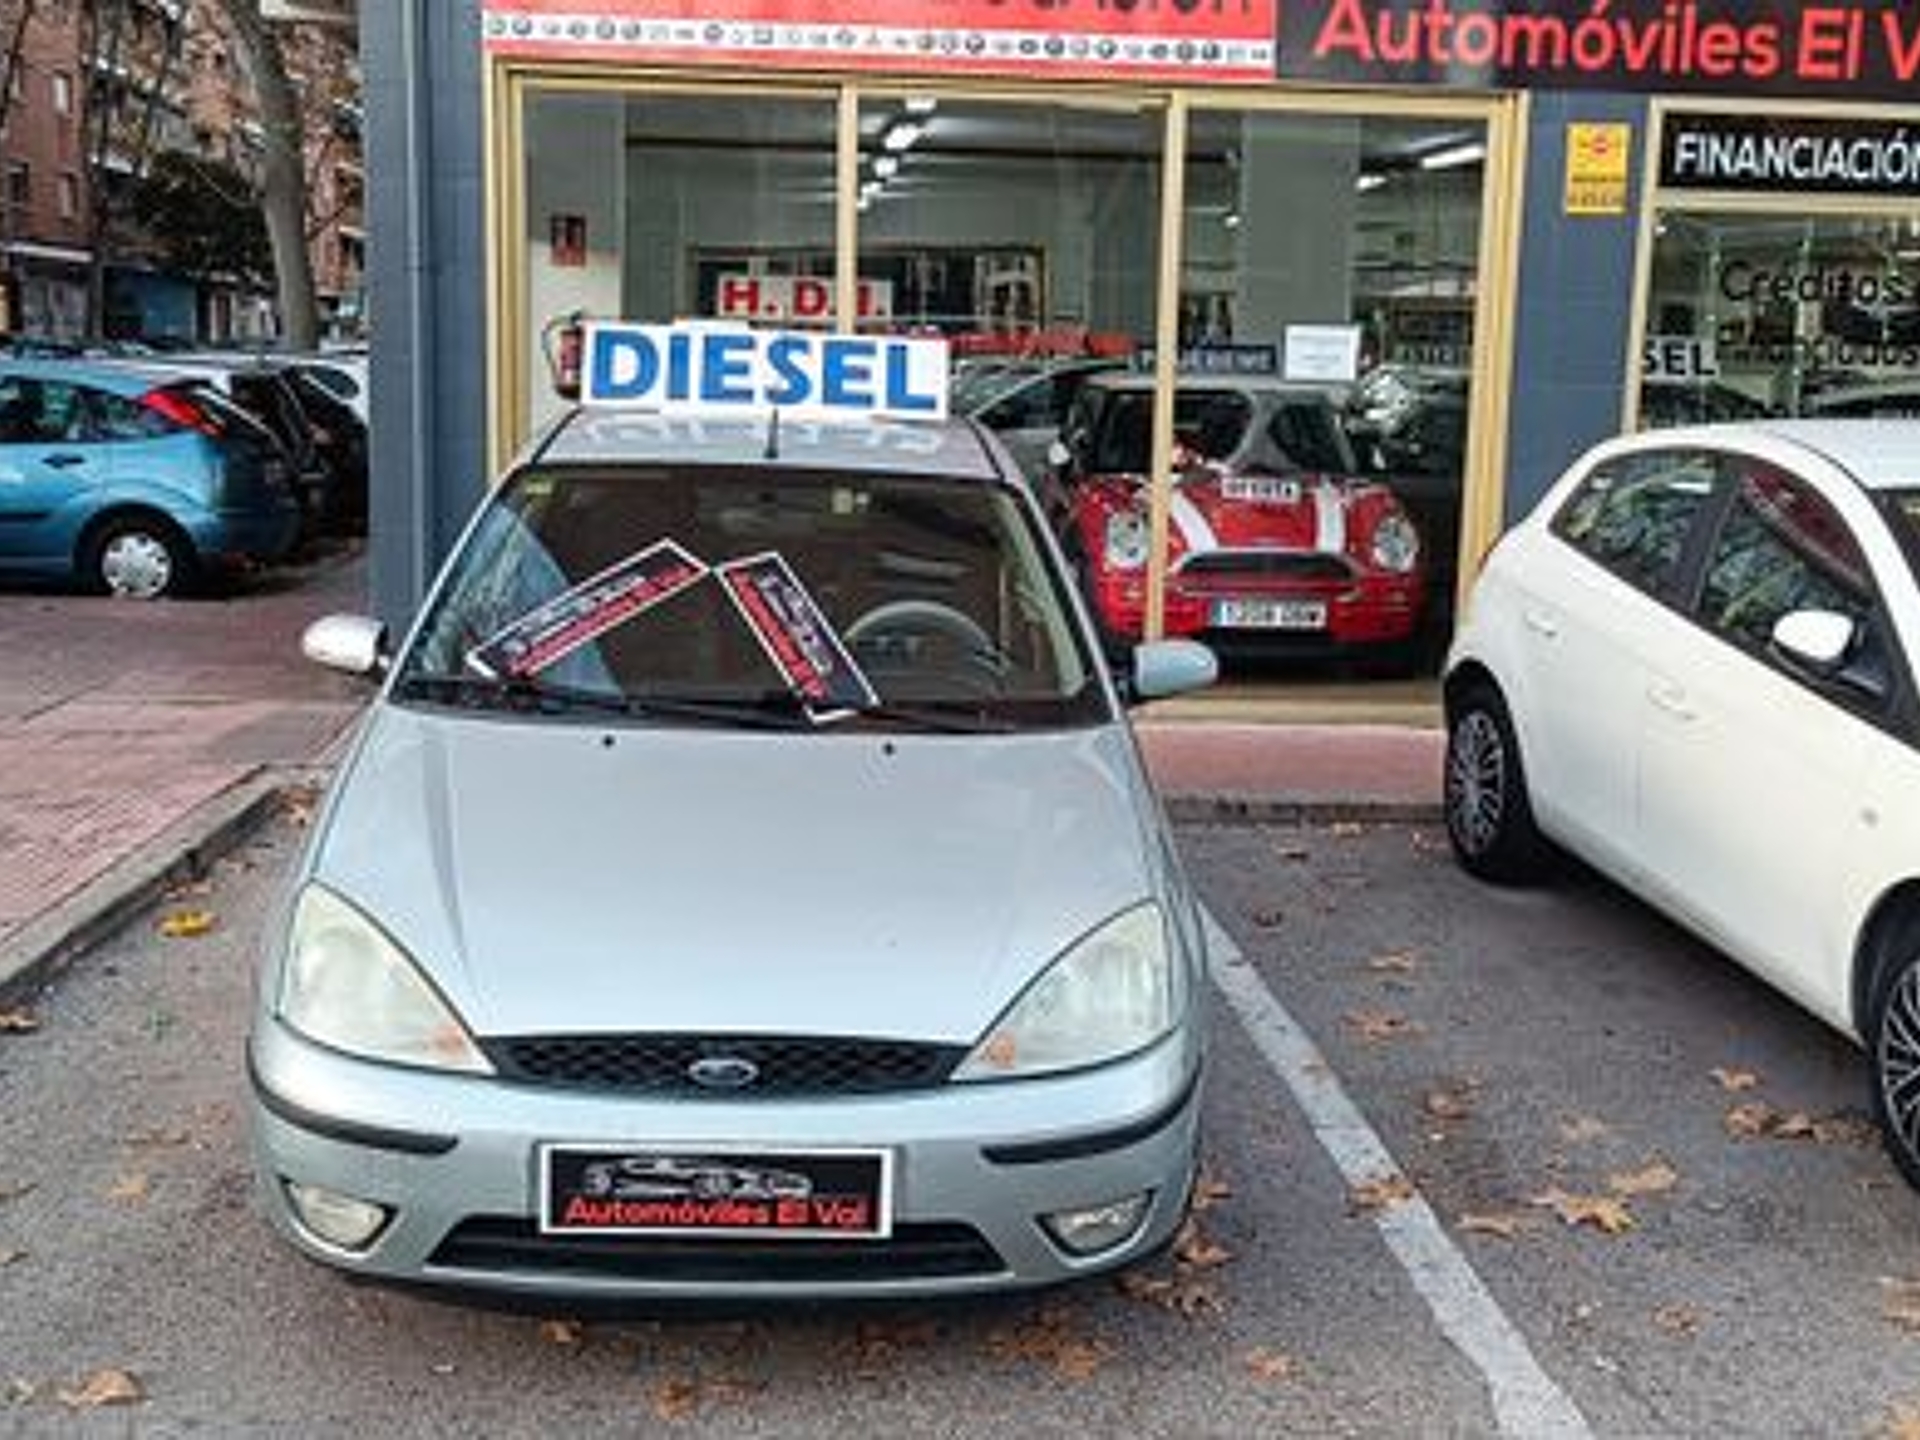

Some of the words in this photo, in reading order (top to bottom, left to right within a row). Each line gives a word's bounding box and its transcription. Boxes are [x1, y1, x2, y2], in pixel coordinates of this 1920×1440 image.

[1314, 0, 1781, 78] Automóviles
[1798, 9, 1864, 80] El
[590, 330, 939, 411] DIESEL
[565, 1195, 769, 1225] Automóviles
[776, 1198, 807, 1226] El
